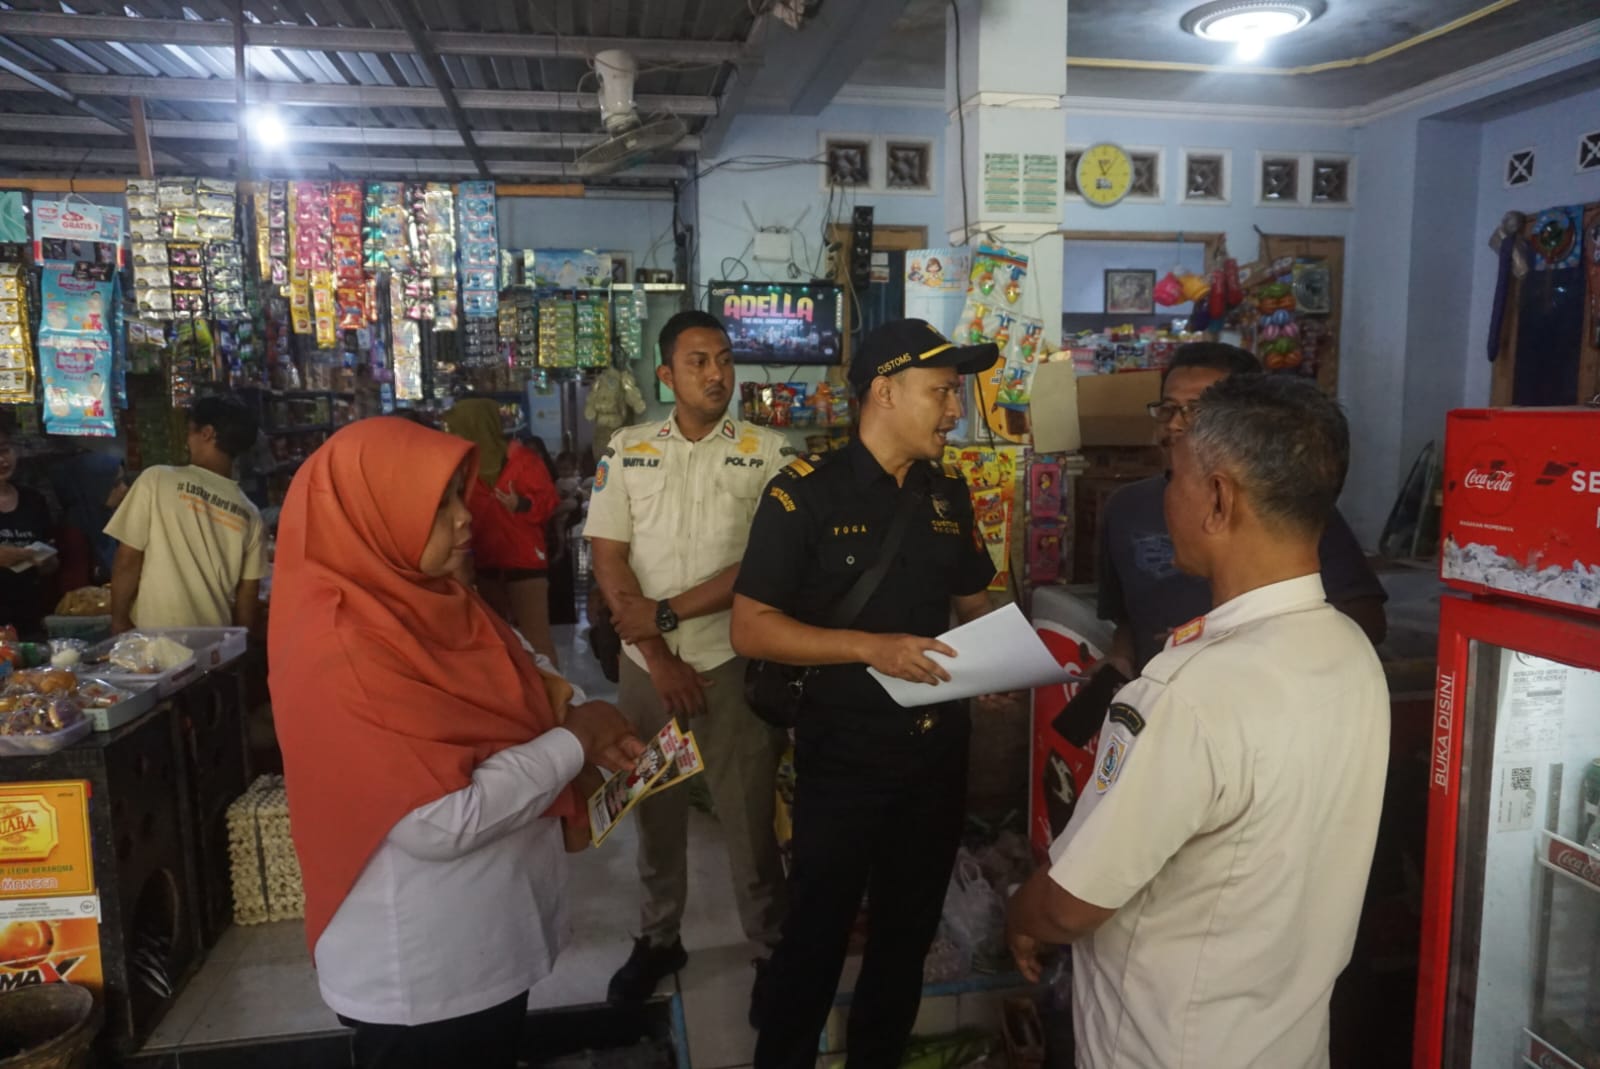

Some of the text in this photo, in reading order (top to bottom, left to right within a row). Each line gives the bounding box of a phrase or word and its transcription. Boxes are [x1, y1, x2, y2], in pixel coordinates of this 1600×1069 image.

[62, 221, 93, 231] GRATIS
[724, 292, 814, 322] ADELLA
[877, 352, 912, 375] CUSTOMS
[833, 524, 868, 536] YOGA
[1435, 674, 1453, 787] BUKA DISINI
